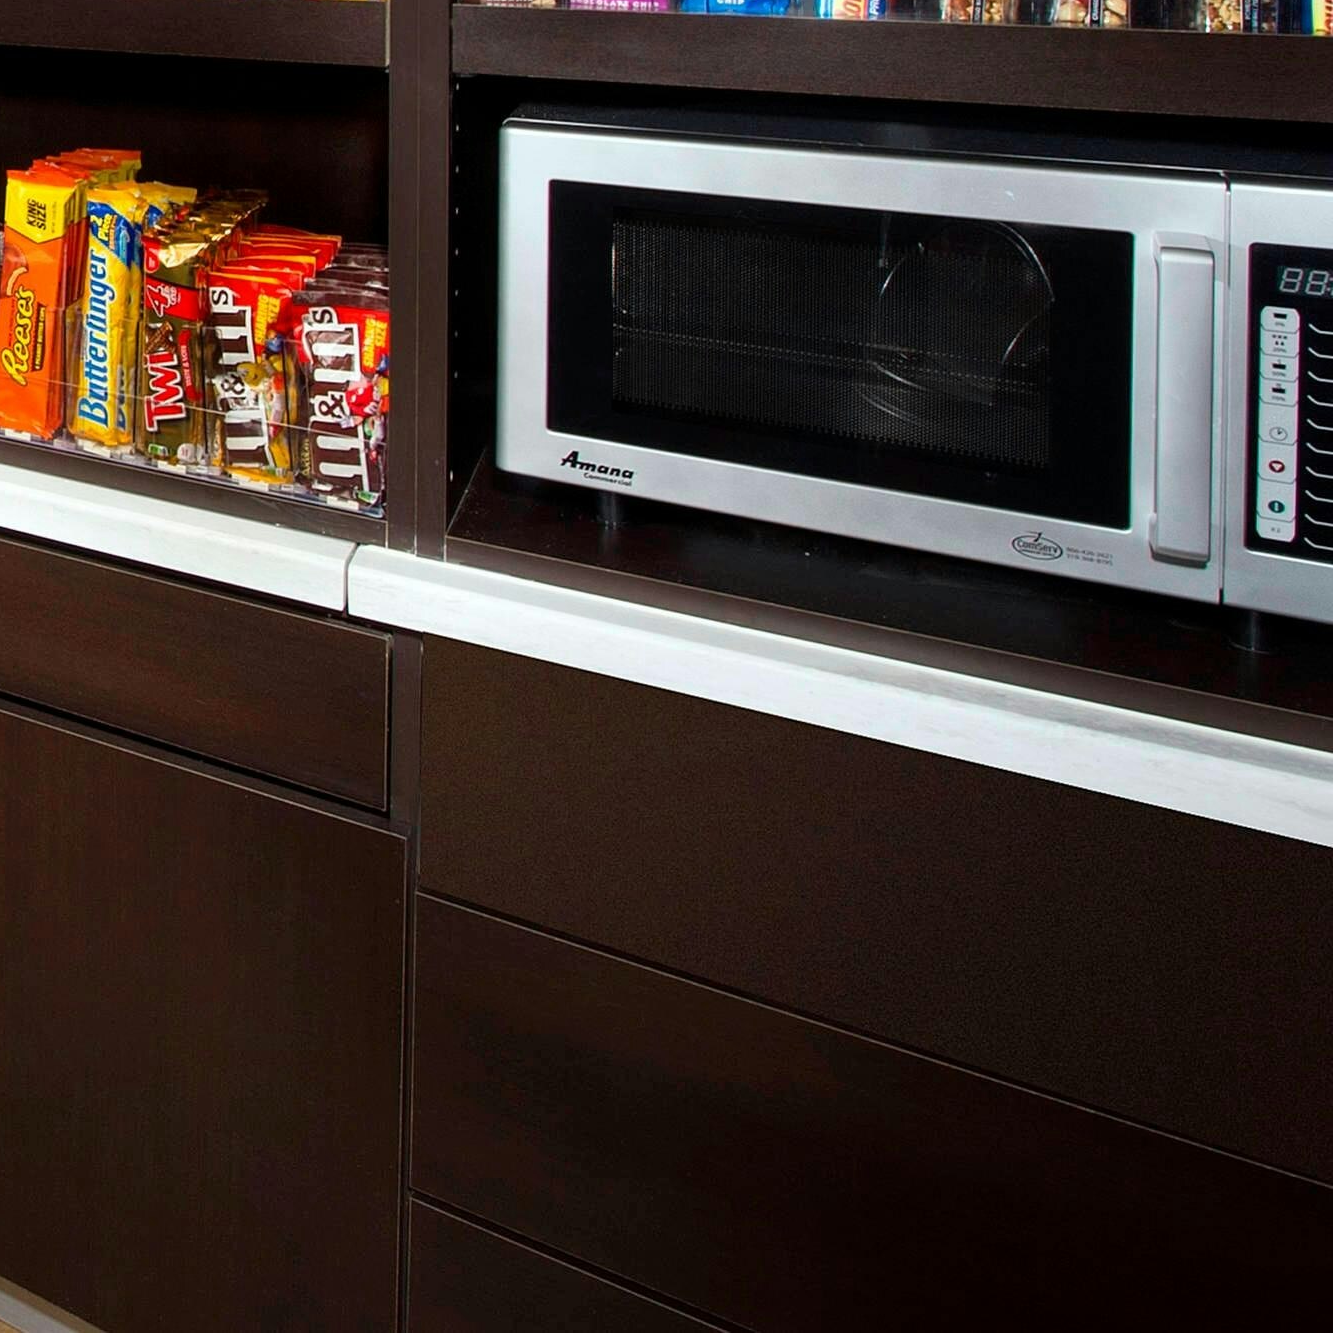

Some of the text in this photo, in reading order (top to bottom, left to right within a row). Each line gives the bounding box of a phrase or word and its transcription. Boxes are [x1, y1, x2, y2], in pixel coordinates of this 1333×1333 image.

[26, 198, 37, 227] KING
[36, 201, 47, 231] SIZE
[90, 214, 102, 227] 2
[254, 294, 270, 346] SHARING
[268, 296, 281, 324] SIZE
[79, 246, 117, 430] Butterfinger
[362, 318, 377, 368] SHARING
[375, 320, 388, 348] SIZE
[561, 450, 634, 480] Amana
[583, 472, 633, 487] Commercial
[1016, 538, 1059, 555] ComServ
